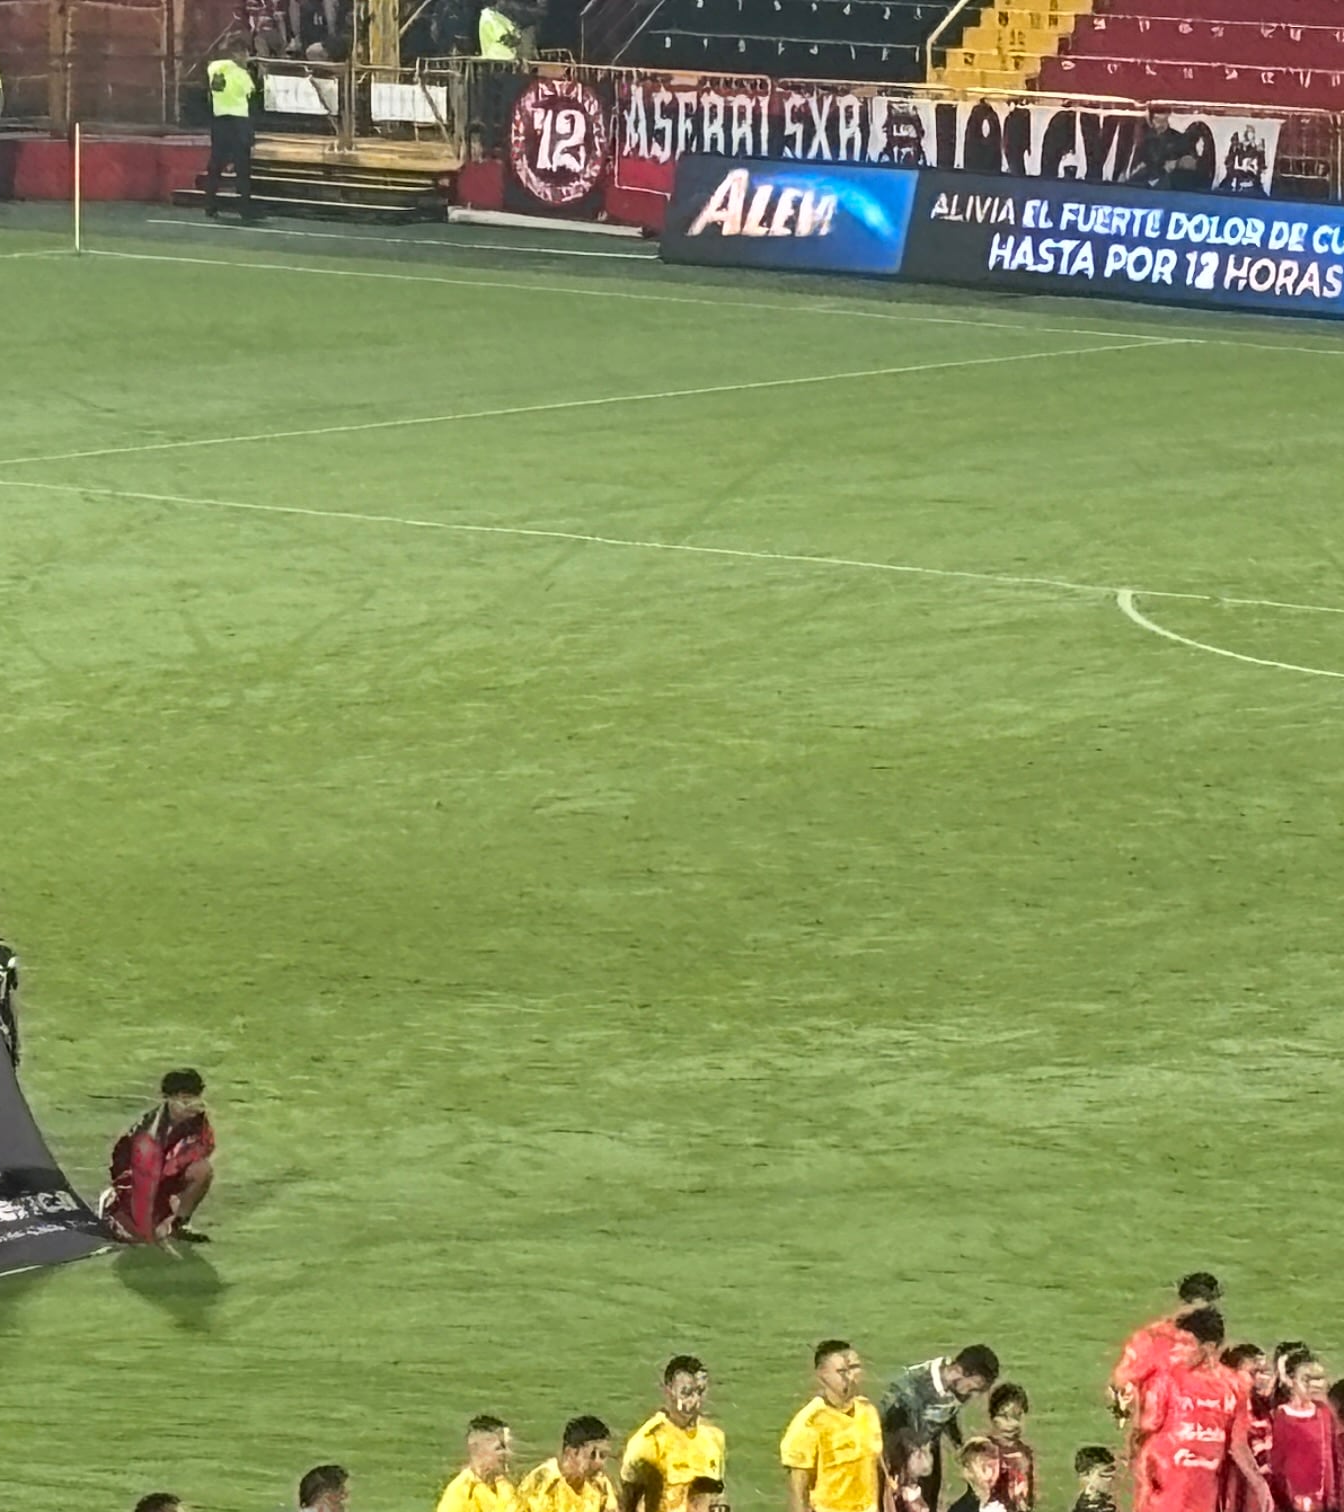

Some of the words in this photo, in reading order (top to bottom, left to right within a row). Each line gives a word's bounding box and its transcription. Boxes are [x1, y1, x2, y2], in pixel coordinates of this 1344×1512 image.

[533, 107, 586, 172] 12
[930, 192, 1016, 226] ALIVIA
[1022, 198, 1054, 230] EL
[1059, 201, 1165, 239] FUERTE
[1166, 210, 1266, 248] DOLOR
[1268, 220, 1309, 253] DE
[988, 231, 1095, 280] HASTA
[1103, 243, 1178, 286] POR
[1185, 249, 1219, 290] 12
[1223, 253, 1344, 298] HORAS
